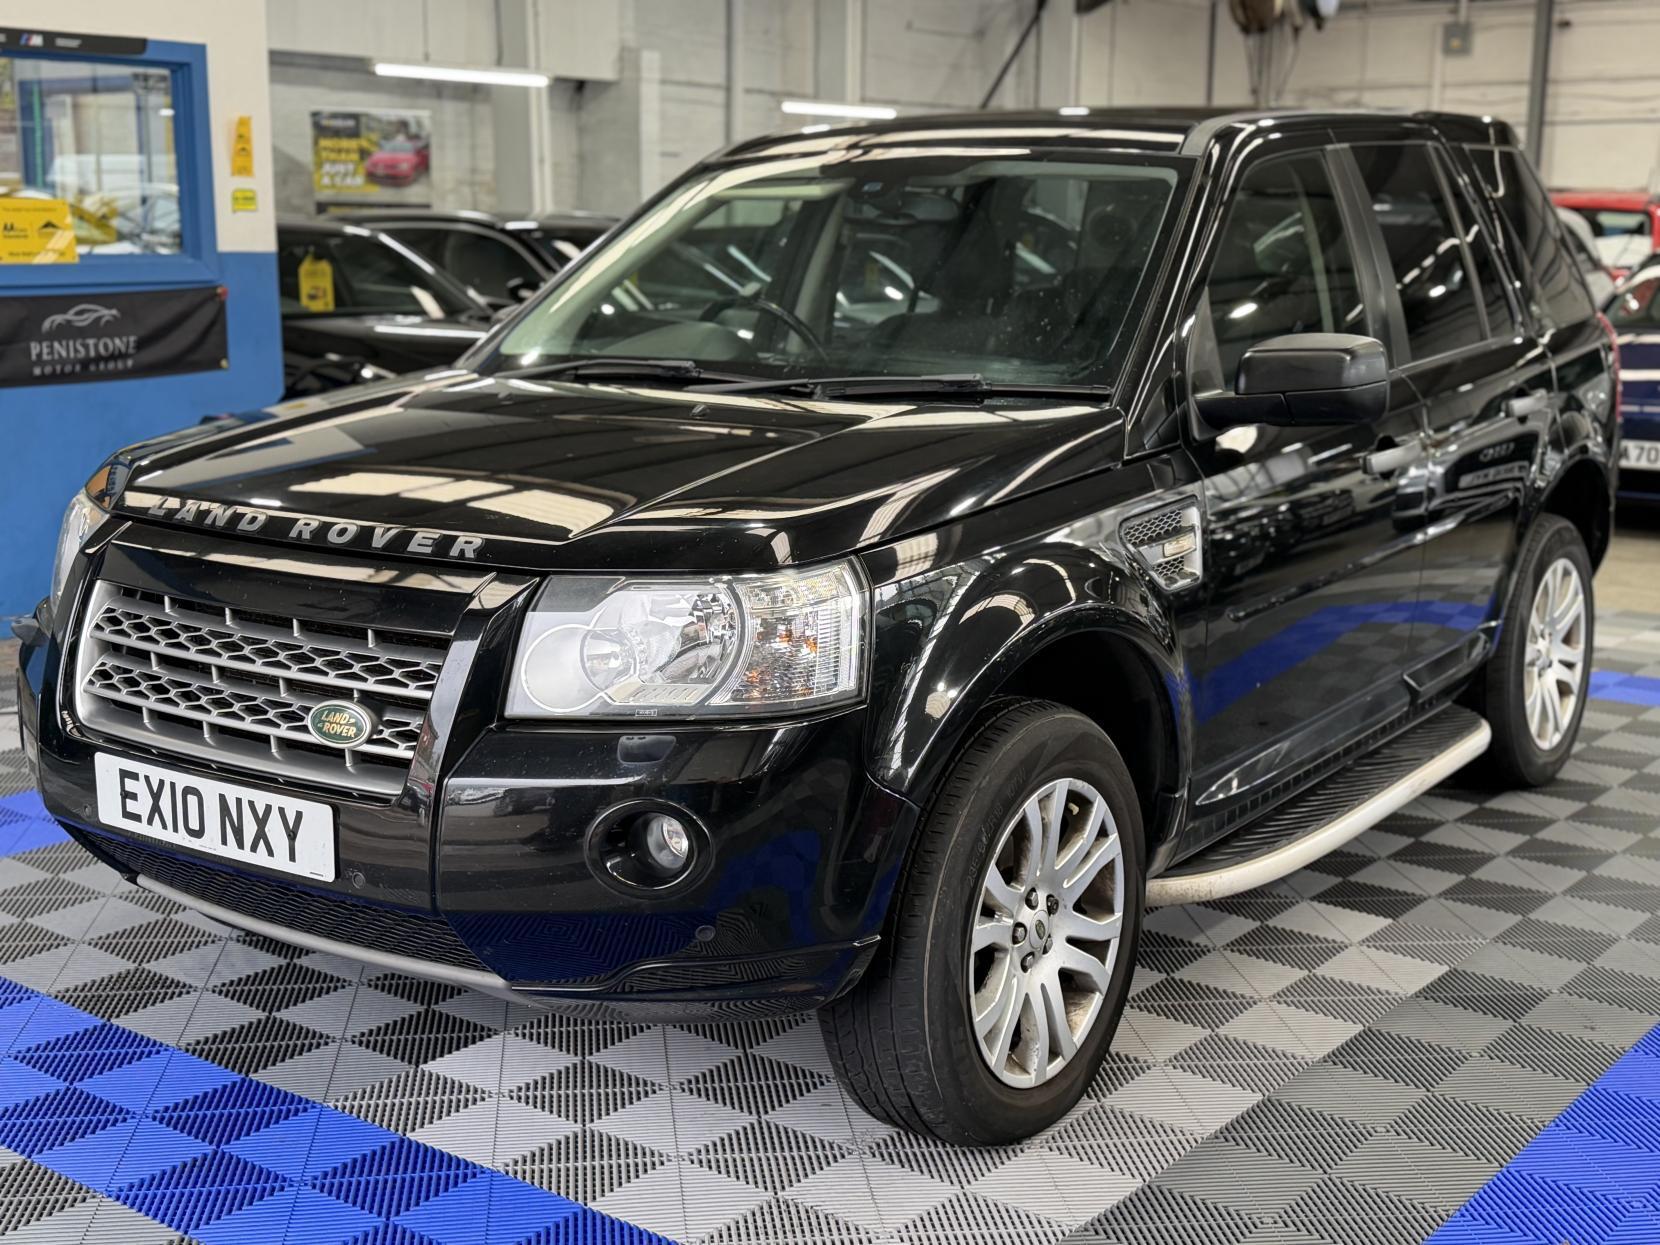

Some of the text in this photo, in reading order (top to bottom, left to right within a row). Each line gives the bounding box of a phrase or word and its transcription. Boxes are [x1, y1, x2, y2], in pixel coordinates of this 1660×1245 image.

[30, 336, 137, 361] PENISTONE
[147, 495, 486, 559] LAND ROVER
[321, 710, 350, 724] LAND
[322, 722, 357, 738] ROVER
[118, 767, 304, 863] EX10 NXY
